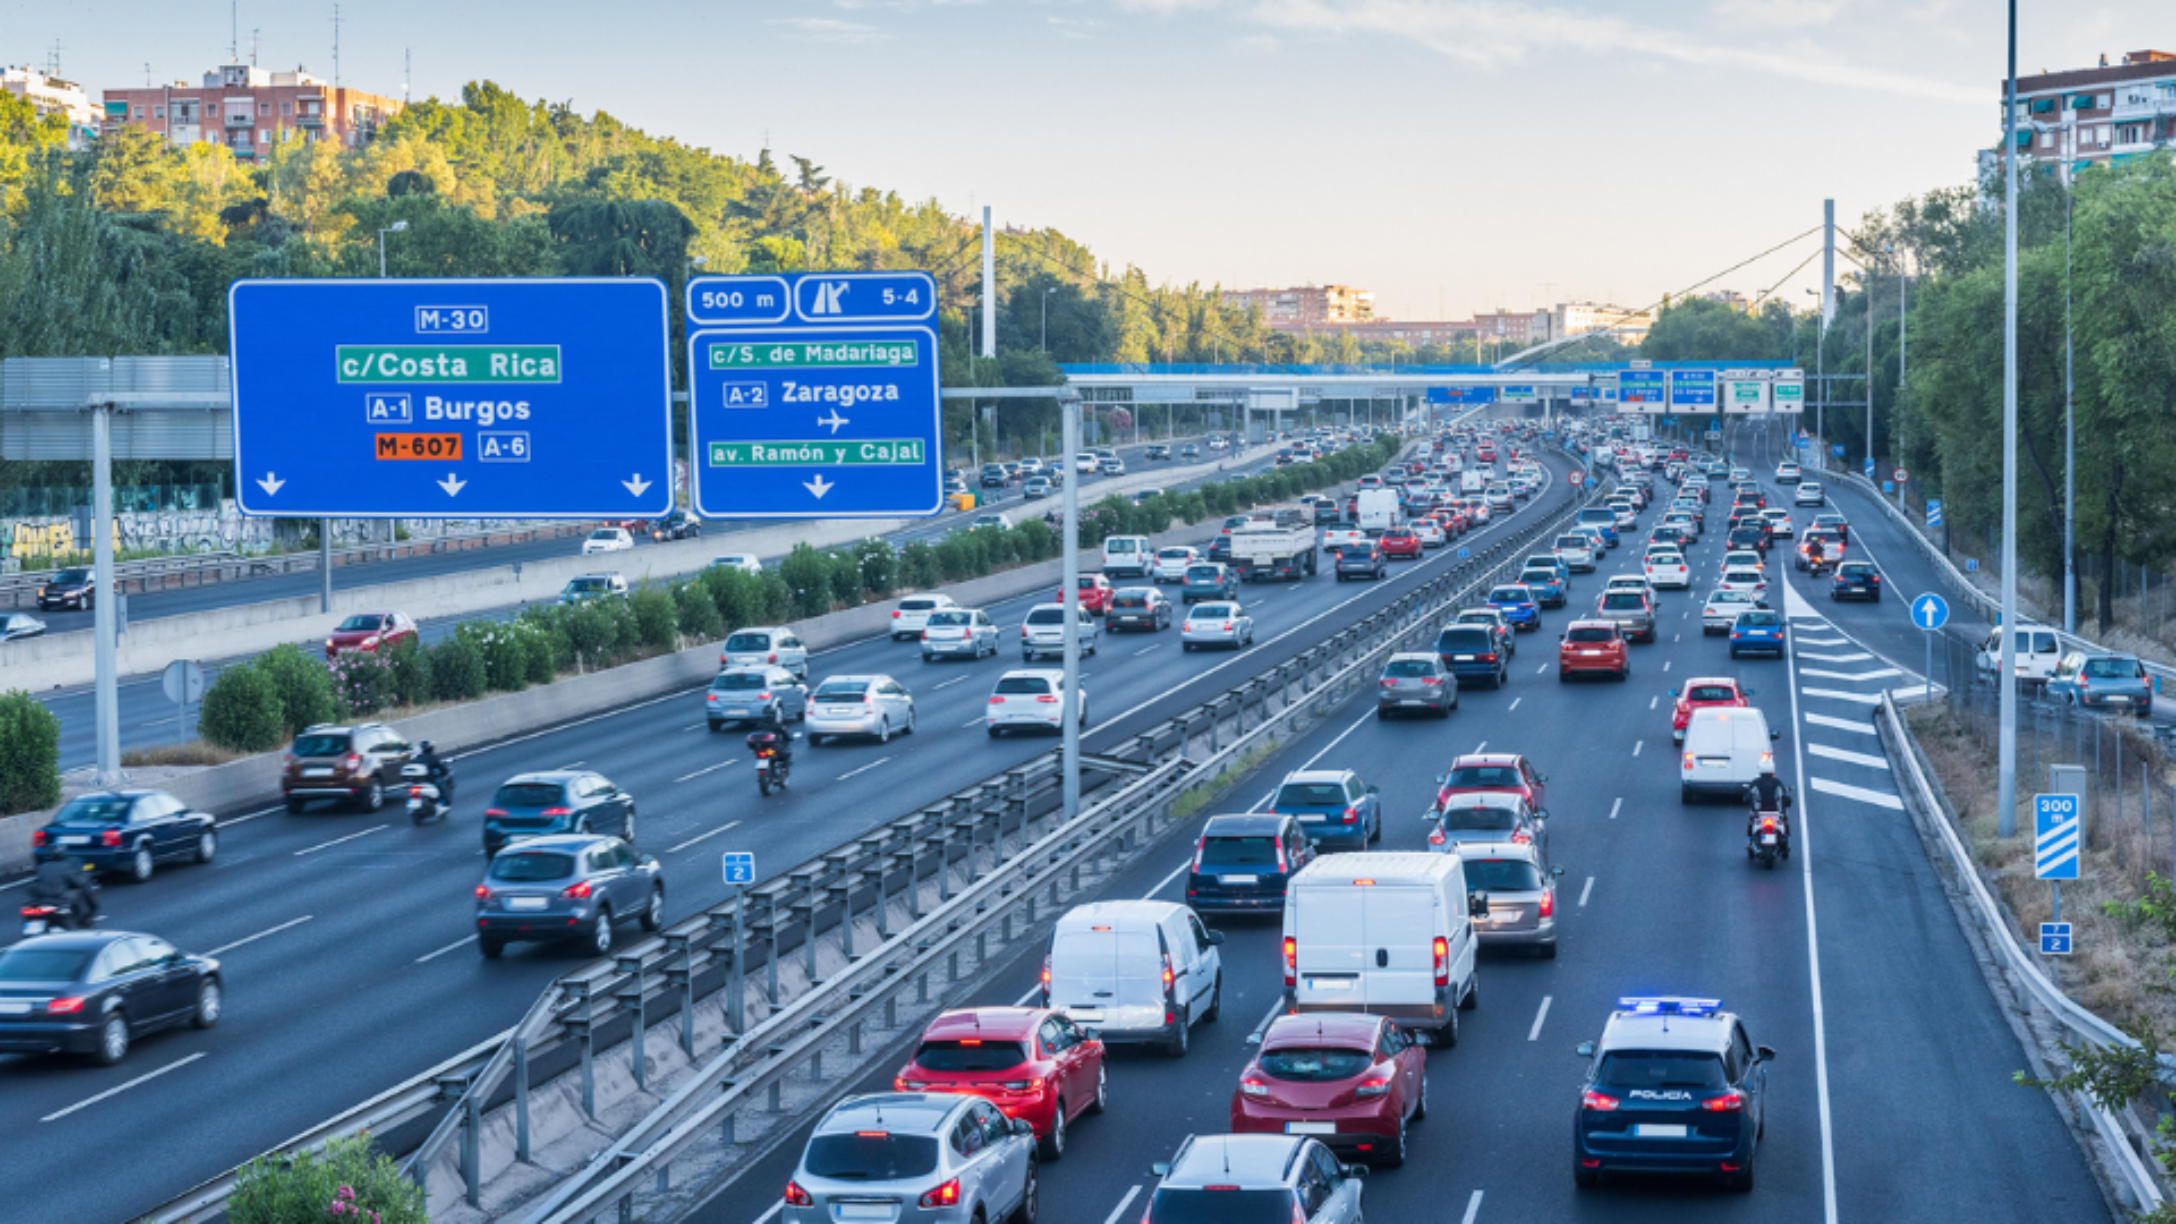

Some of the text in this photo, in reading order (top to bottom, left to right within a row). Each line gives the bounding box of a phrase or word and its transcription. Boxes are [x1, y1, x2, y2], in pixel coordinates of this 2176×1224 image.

[702, 291, 774, 309] 500 m
[882, 288, 920, 305] 5-4
[420, 310, 484, 329] M-30
[770, 345, 796, 361] de
[805, 344, 914, 365] Madariaga
[342, 353, 556, 377] c/Costa Rica
[729, 381, 899, 407] A-2 Zaragoza
[371, 396, 531, 426] A-1 Burgos
[378, 437, 525, 457] M-607 A-6
[713, 441, 920, 465] av. Ramón y Cajal
[2041, 800, 2072, 812] 300
[2051, 814, 2064, 823] m
[734, 868, 744, 880] 2
[2051, 938, 2061, 950] 2
